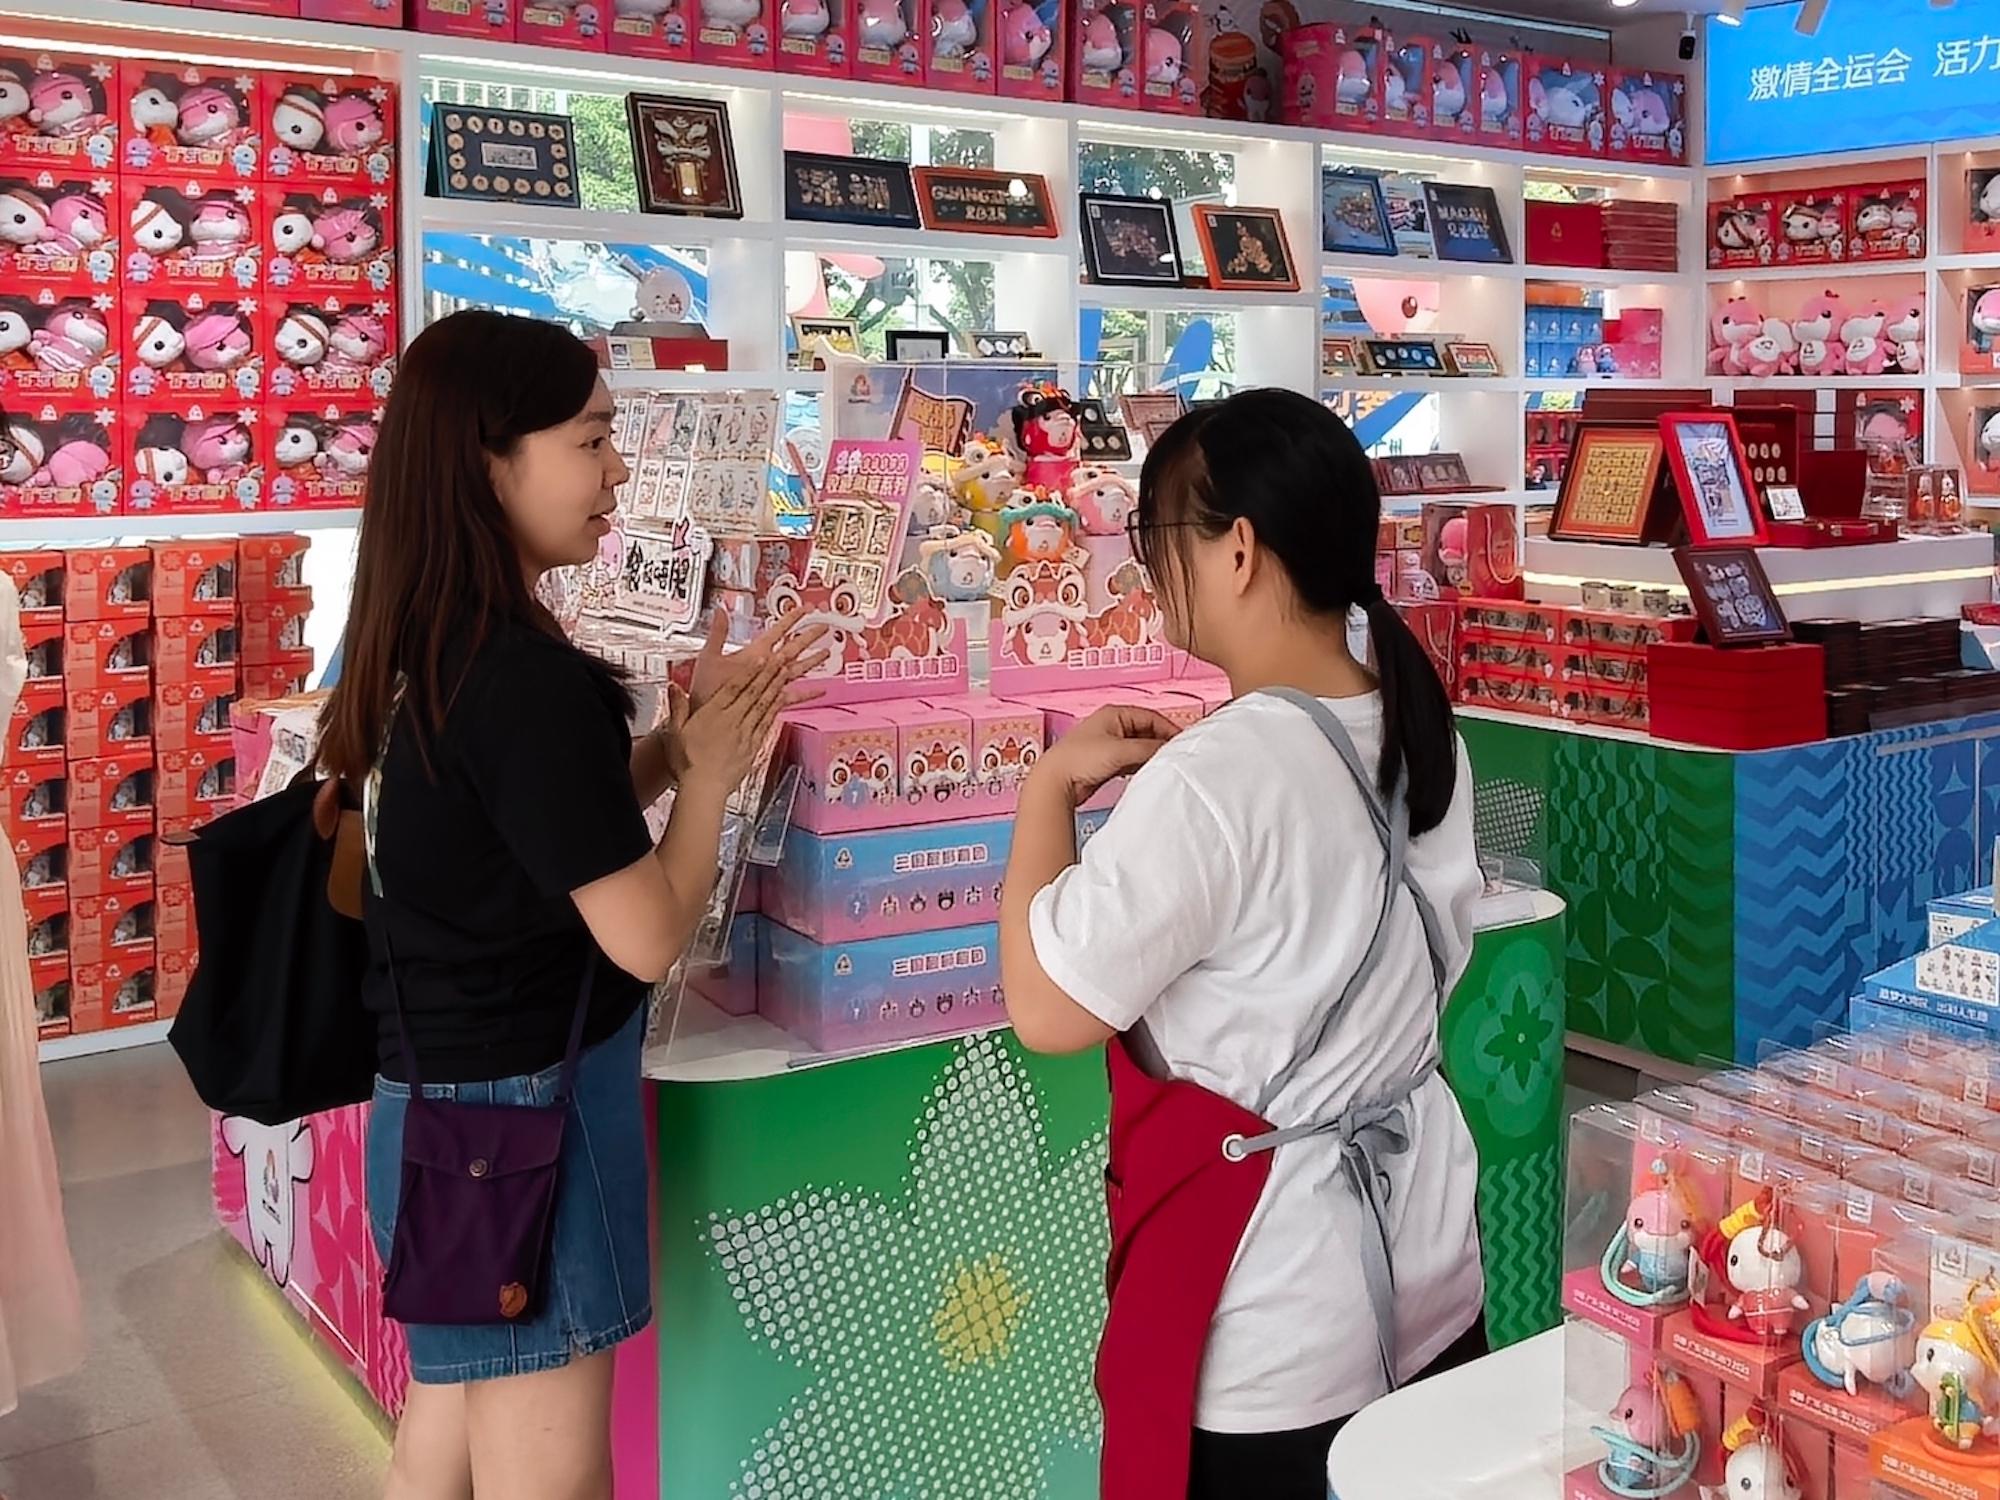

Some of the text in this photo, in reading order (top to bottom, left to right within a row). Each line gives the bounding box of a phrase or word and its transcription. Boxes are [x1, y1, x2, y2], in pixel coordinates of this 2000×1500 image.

[1748, 35, 2000, 101] 激情全运会 活力
